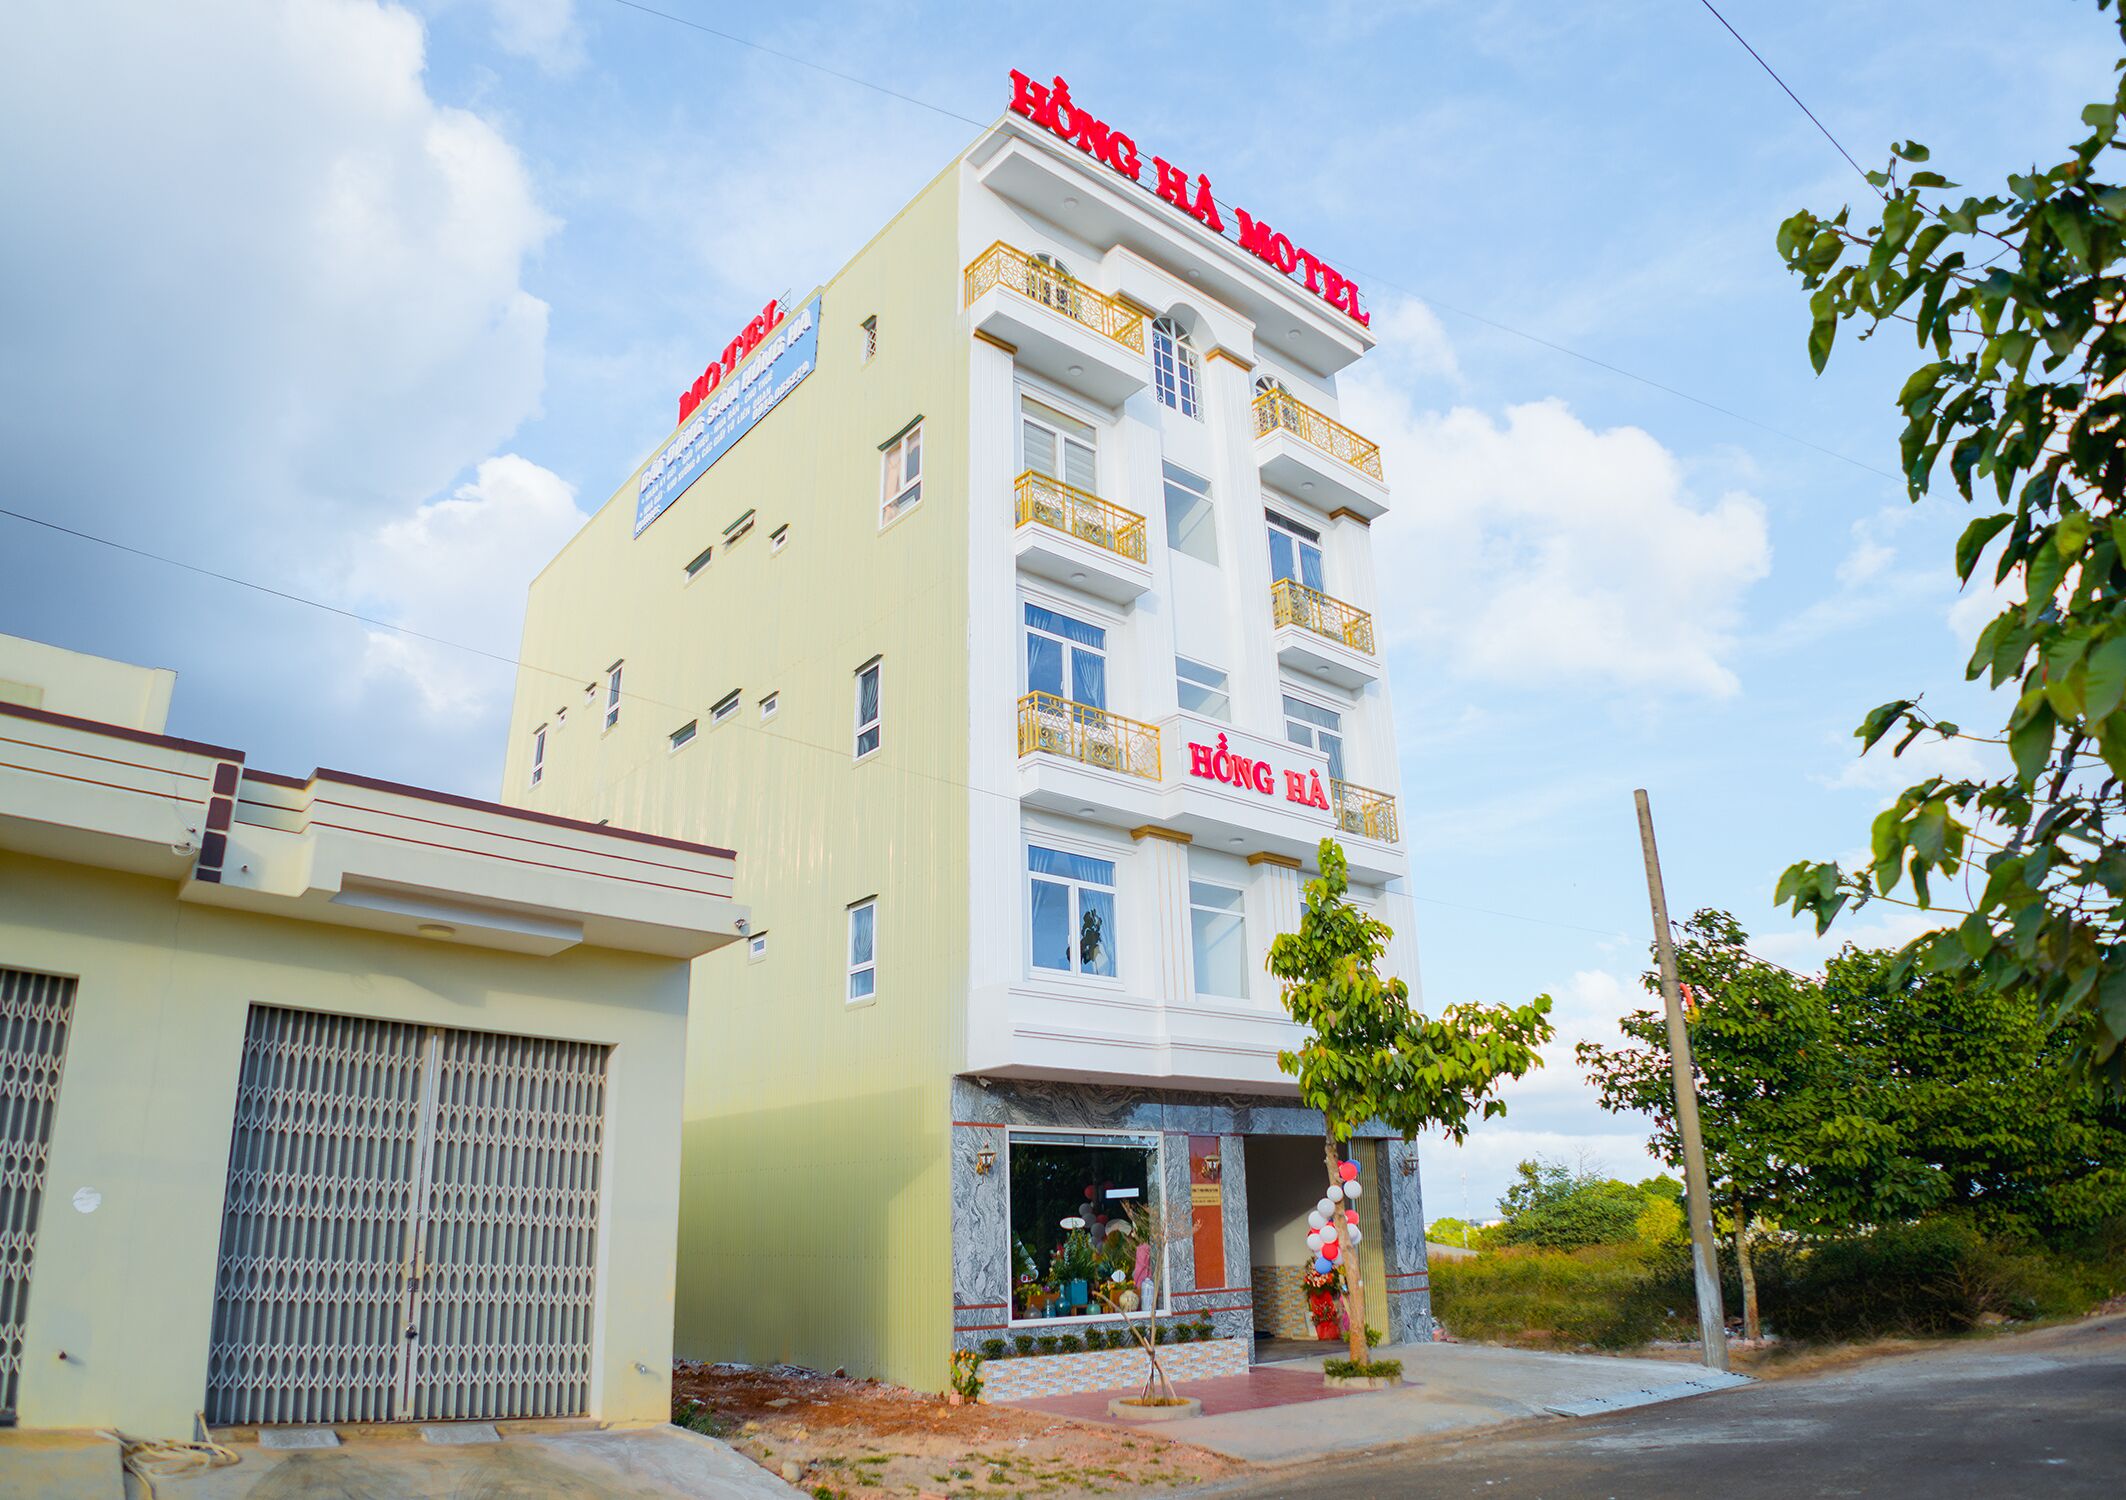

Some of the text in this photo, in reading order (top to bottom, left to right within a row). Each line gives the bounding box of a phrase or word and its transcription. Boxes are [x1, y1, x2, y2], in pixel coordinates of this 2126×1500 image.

[1010, 69, 1369, 327] HỒNG HÀ MOTEL
[679, 300, 784, 425] MOTEL
[1188, 733, 1329, 810] HỒNG HÀ
